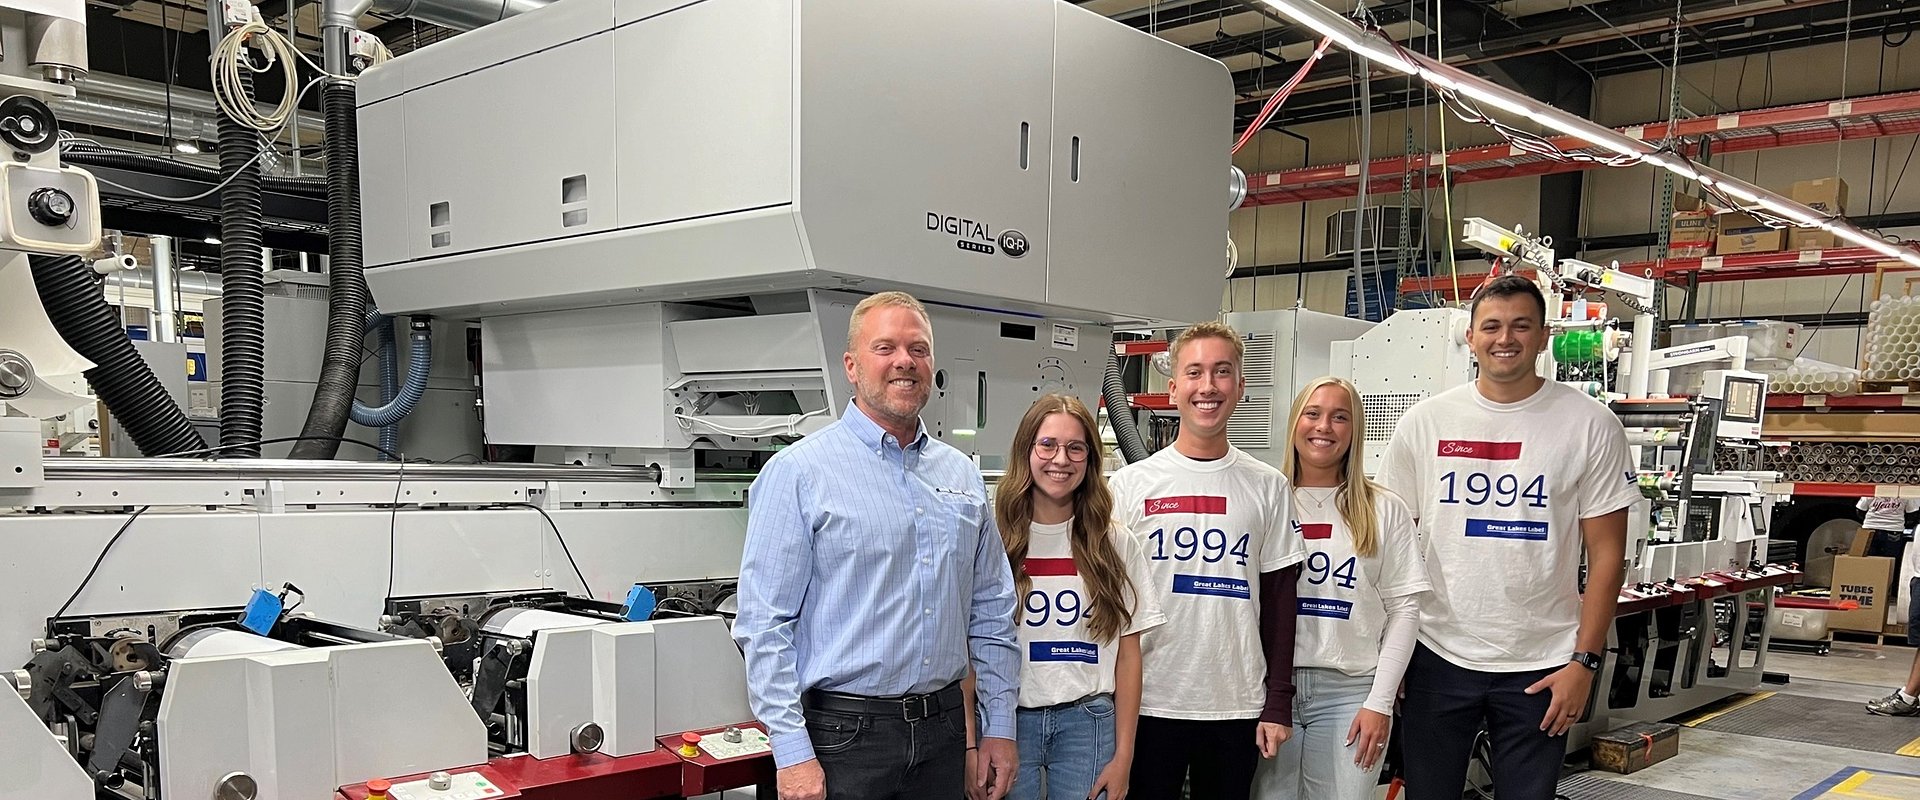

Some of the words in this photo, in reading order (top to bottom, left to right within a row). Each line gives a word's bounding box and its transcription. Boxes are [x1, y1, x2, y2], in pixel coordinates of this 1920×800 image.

[926, 211, 996, 242] DIGITAL
[959, 240, 993, 253] SERIES
[1442, 442, 1474, 454] Since
[1439, 471, 1549, 508] 1994
[1148, 500, 1180, 513] Since
[1148, 526, 1250, 566] 1994
[1193, 580, 1212, 588] Great
[1840, 584, 1874, 594] TUBES
[1051, 646, 1070, 654] Great
